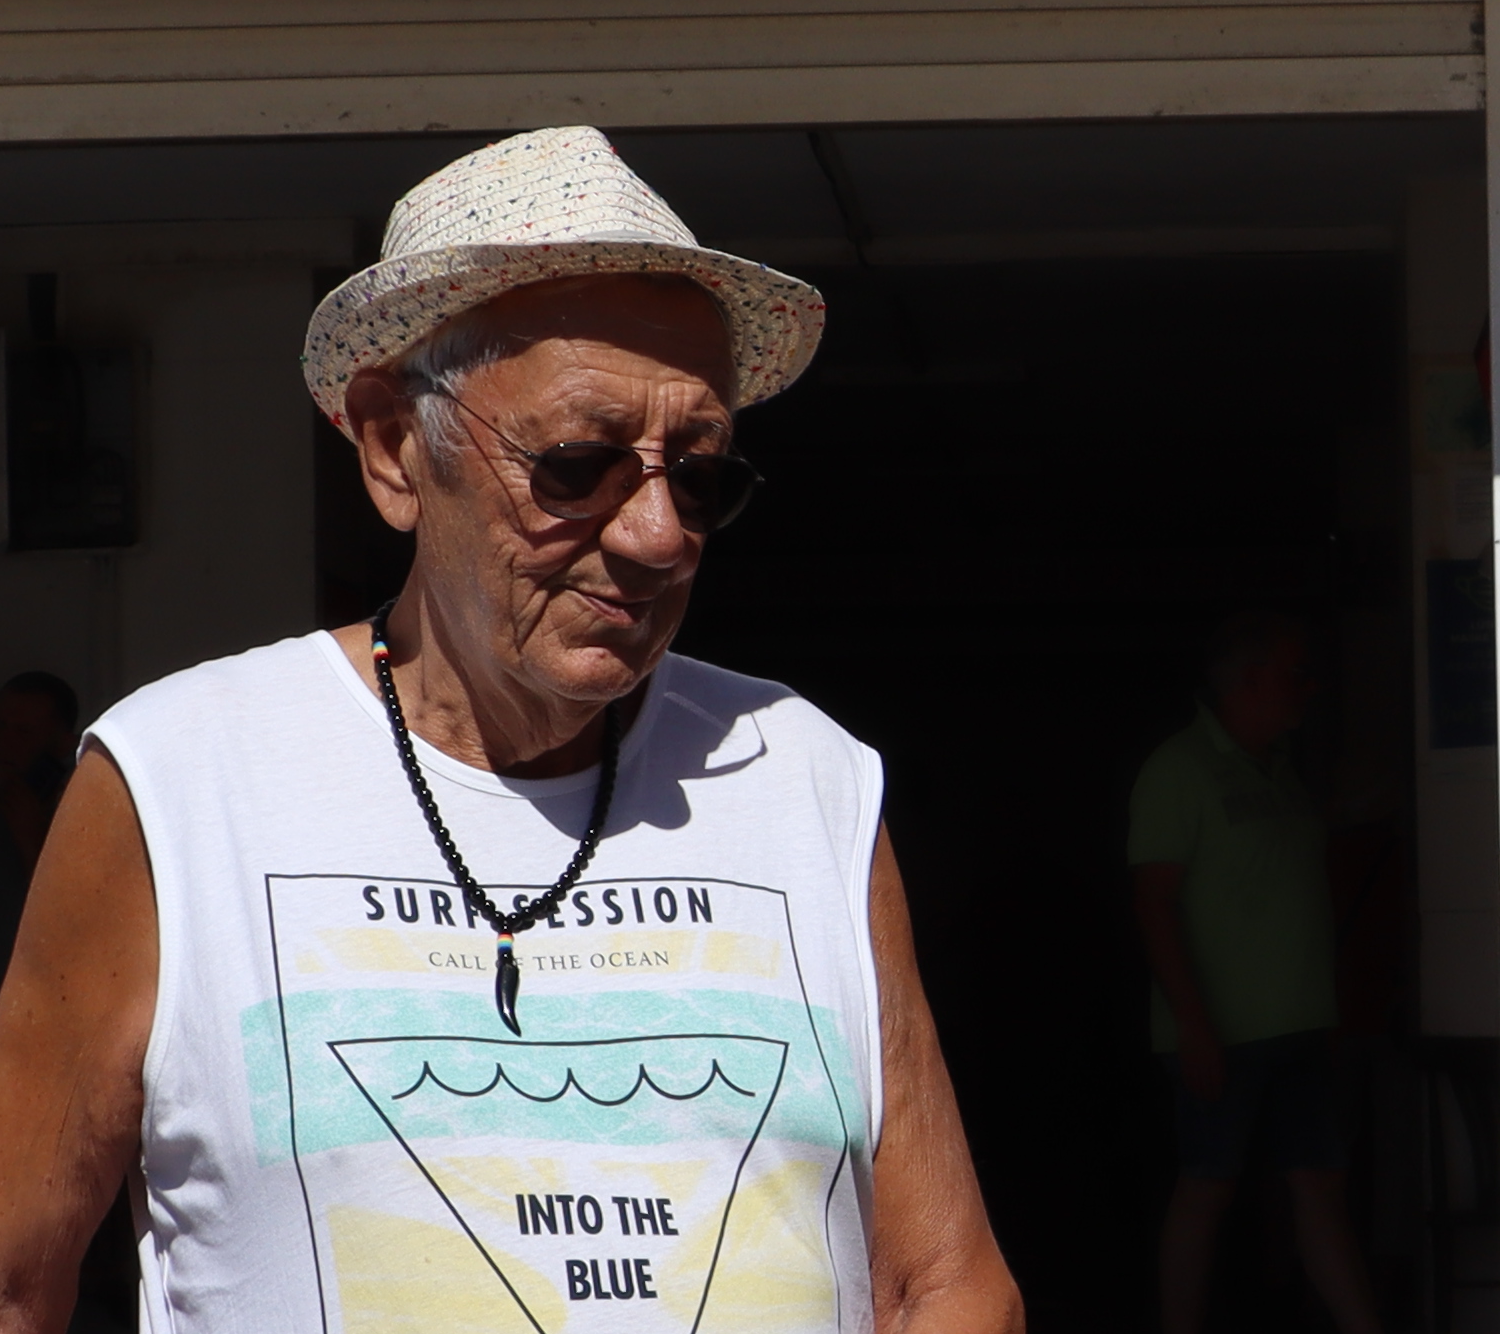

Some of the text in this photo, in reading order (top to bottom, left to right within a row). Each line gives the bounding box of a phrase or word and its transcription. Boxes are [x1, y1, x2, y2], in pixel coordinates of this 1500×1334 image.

[429, 951, 488, 971] CALL
[532, 954, 582, 971] THE
[590, 950, 670, 969] OCEAN
[515, 1193, 679, 1237] INTO THE
[565, 1257, 658, 1301] BLUE
